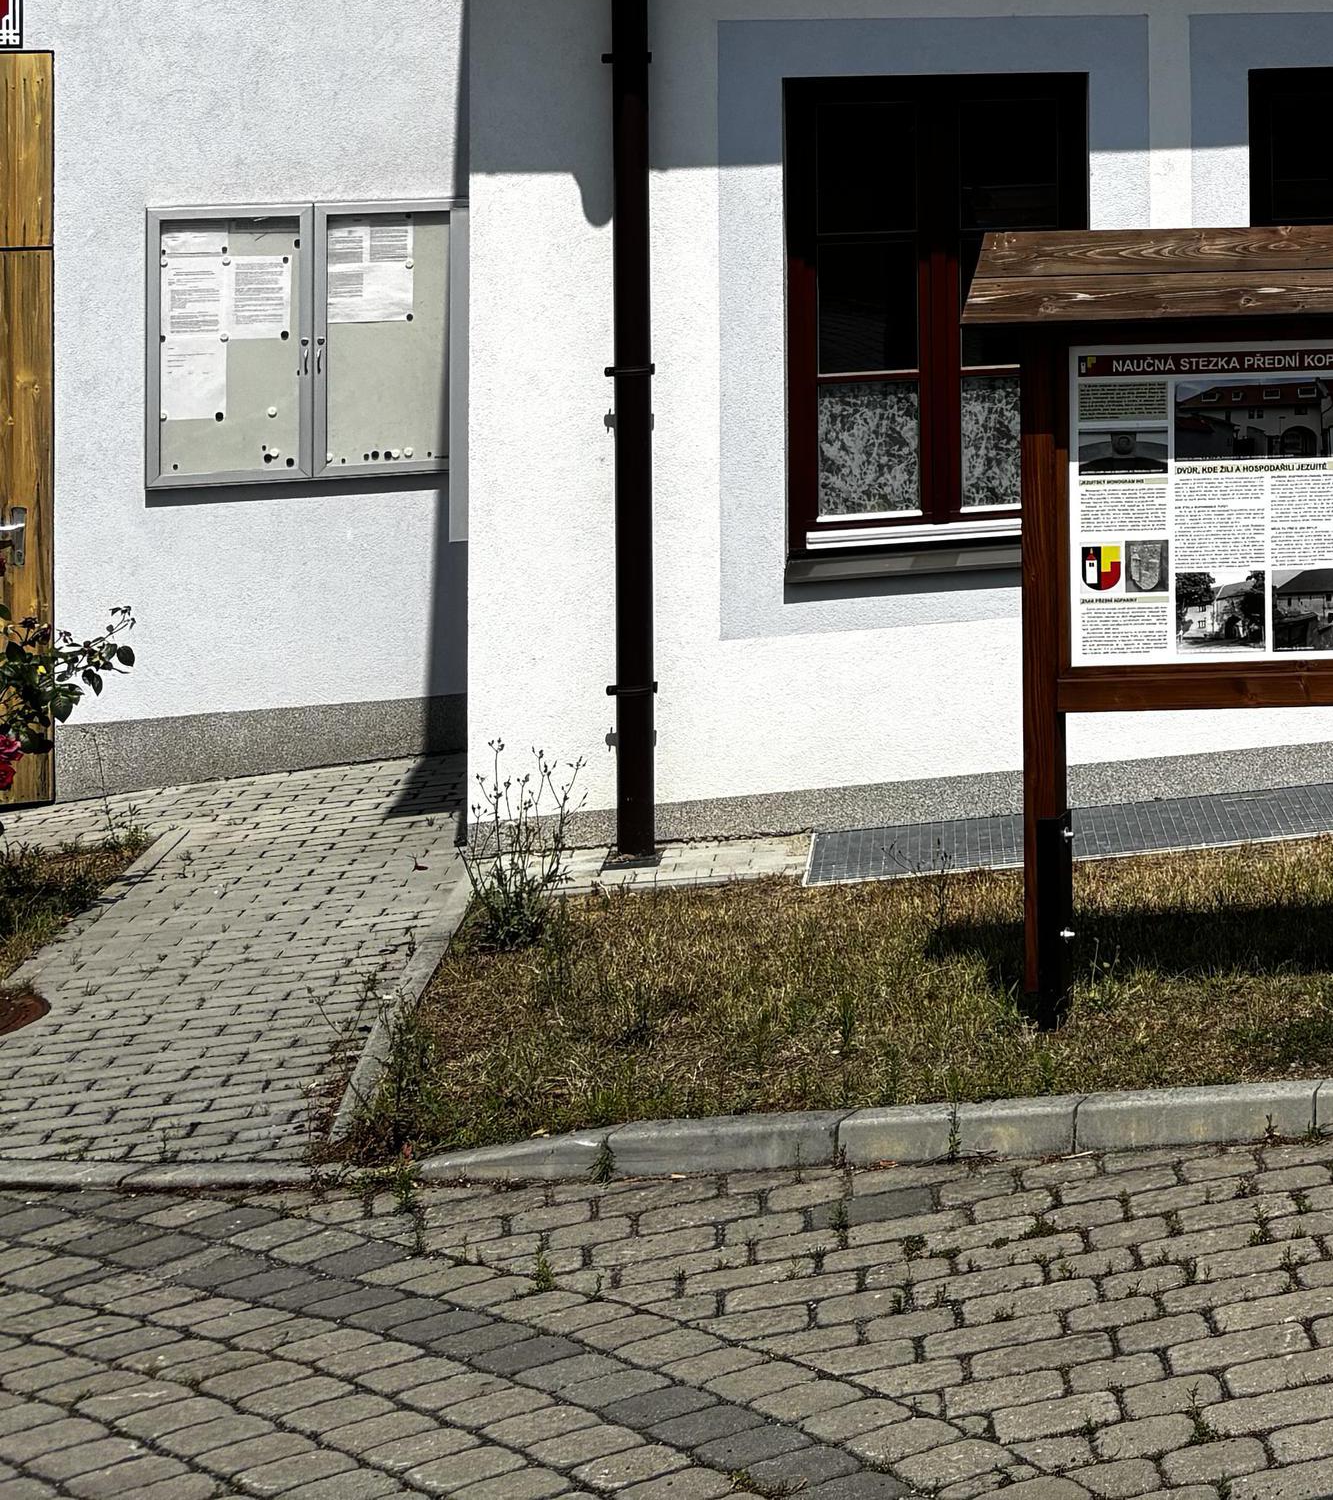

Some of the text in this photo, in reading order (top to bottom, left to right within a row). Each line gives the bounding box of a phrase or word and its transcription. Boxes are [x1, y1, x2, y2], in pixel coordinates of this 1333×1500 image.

[1112, 355, 1176, 373] NAUČNÁ
[1180, 356, 1240, 371] STEZKA
[1244, 353, 1300, 369] PŘEDNÍ
[1177, 466, 1200, 475] DVŮR,
[1202, 466, 1219, 474] KDE
[1219, 465, 1234, 473] ŽILI
[1243, 463, 1295, 472] HOSPODAŘILI
[1295, 462, 1328, 471] JEZUITÉ
